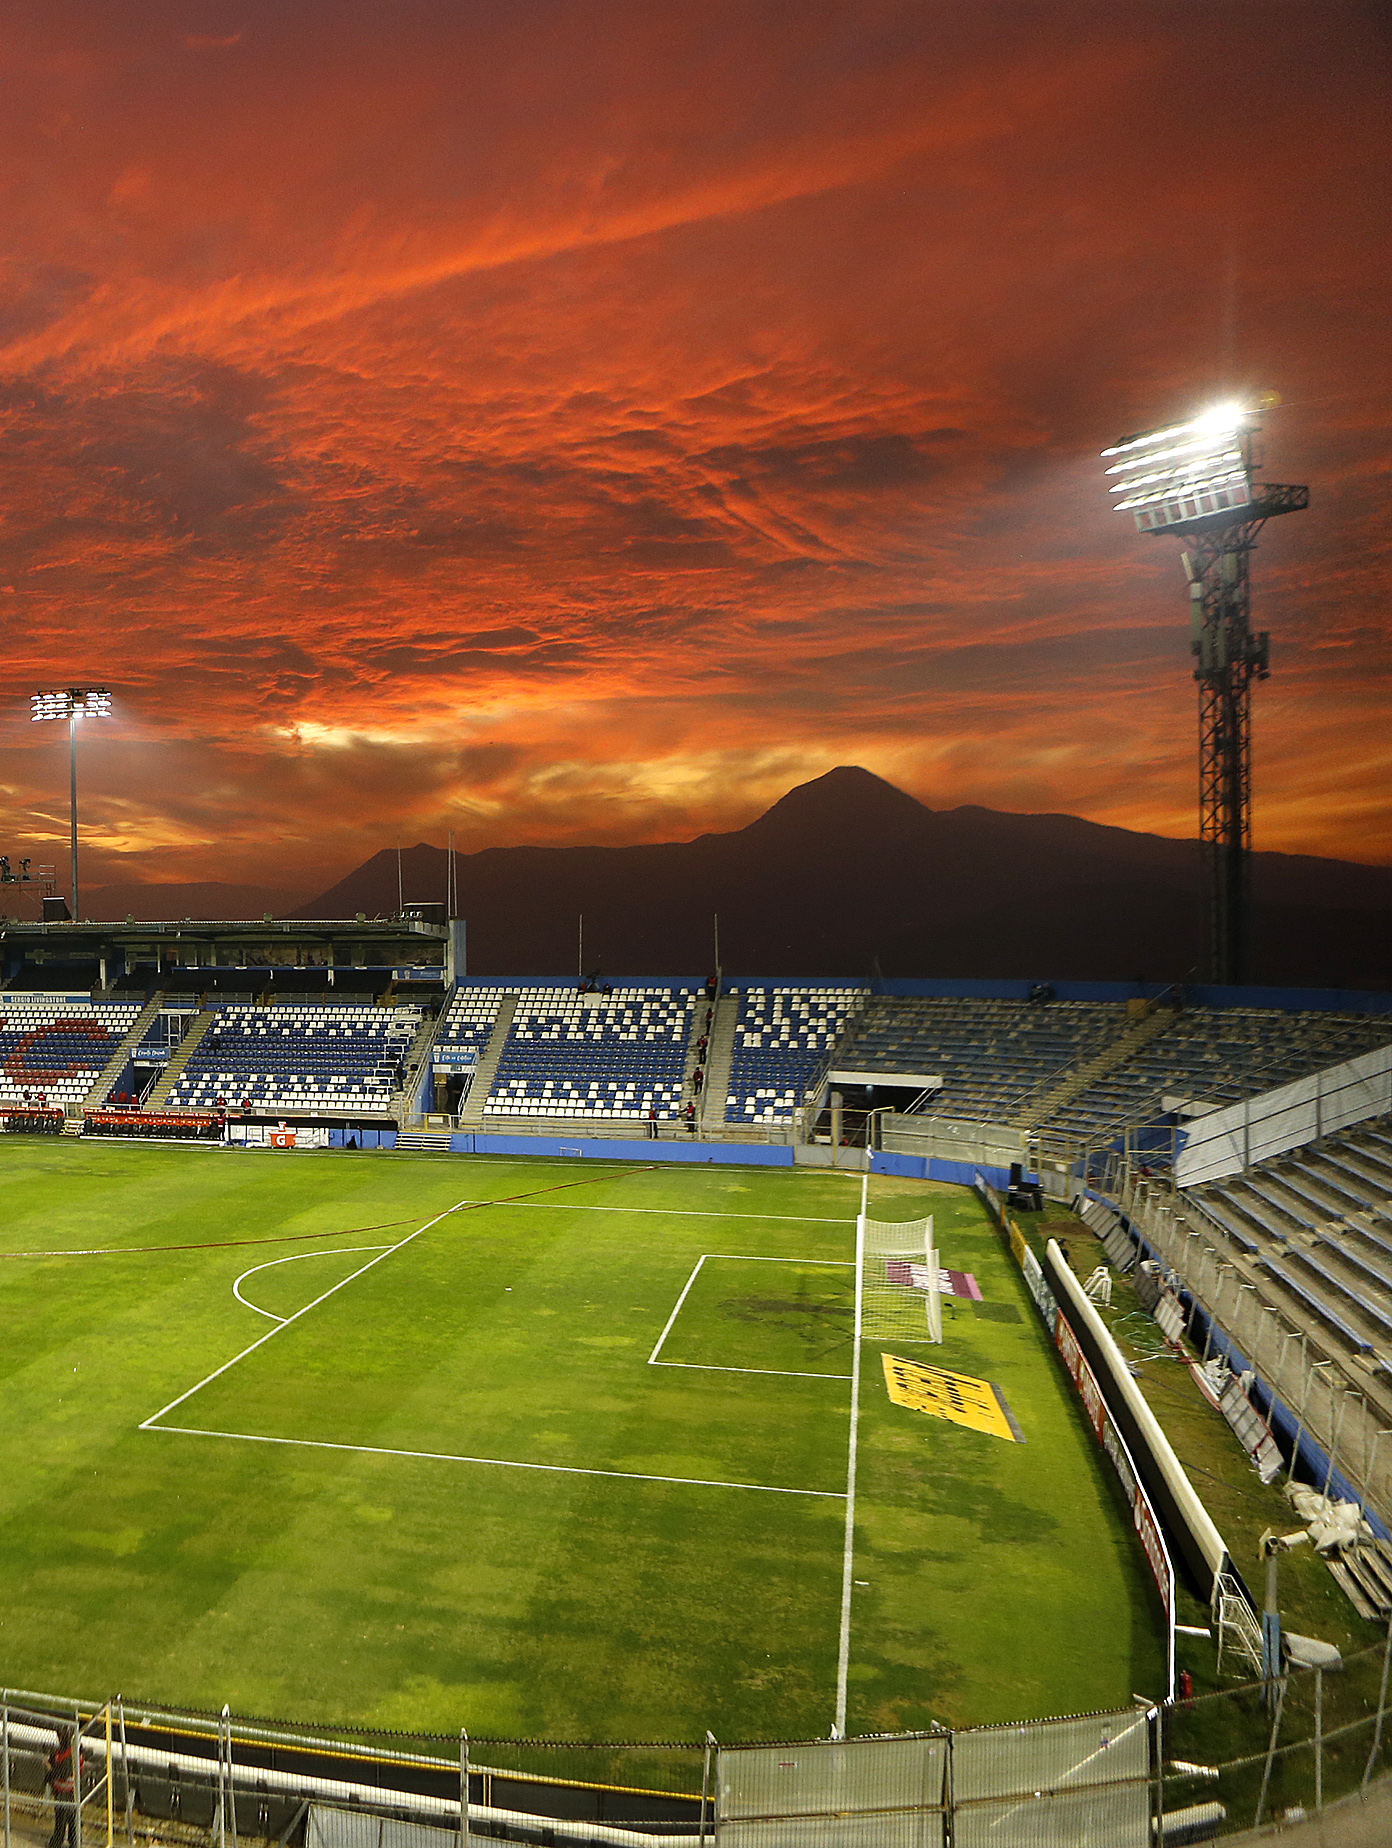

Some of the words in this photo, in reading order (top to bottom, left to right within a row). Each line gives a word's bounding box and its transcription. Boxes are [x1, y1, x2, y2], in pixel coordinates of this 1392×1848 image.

[10, 996, 30, 1004] SERGIO
[31, 996, 67, 1004] LIVINGSTONE
[276, 1134, 286, 1146] G
